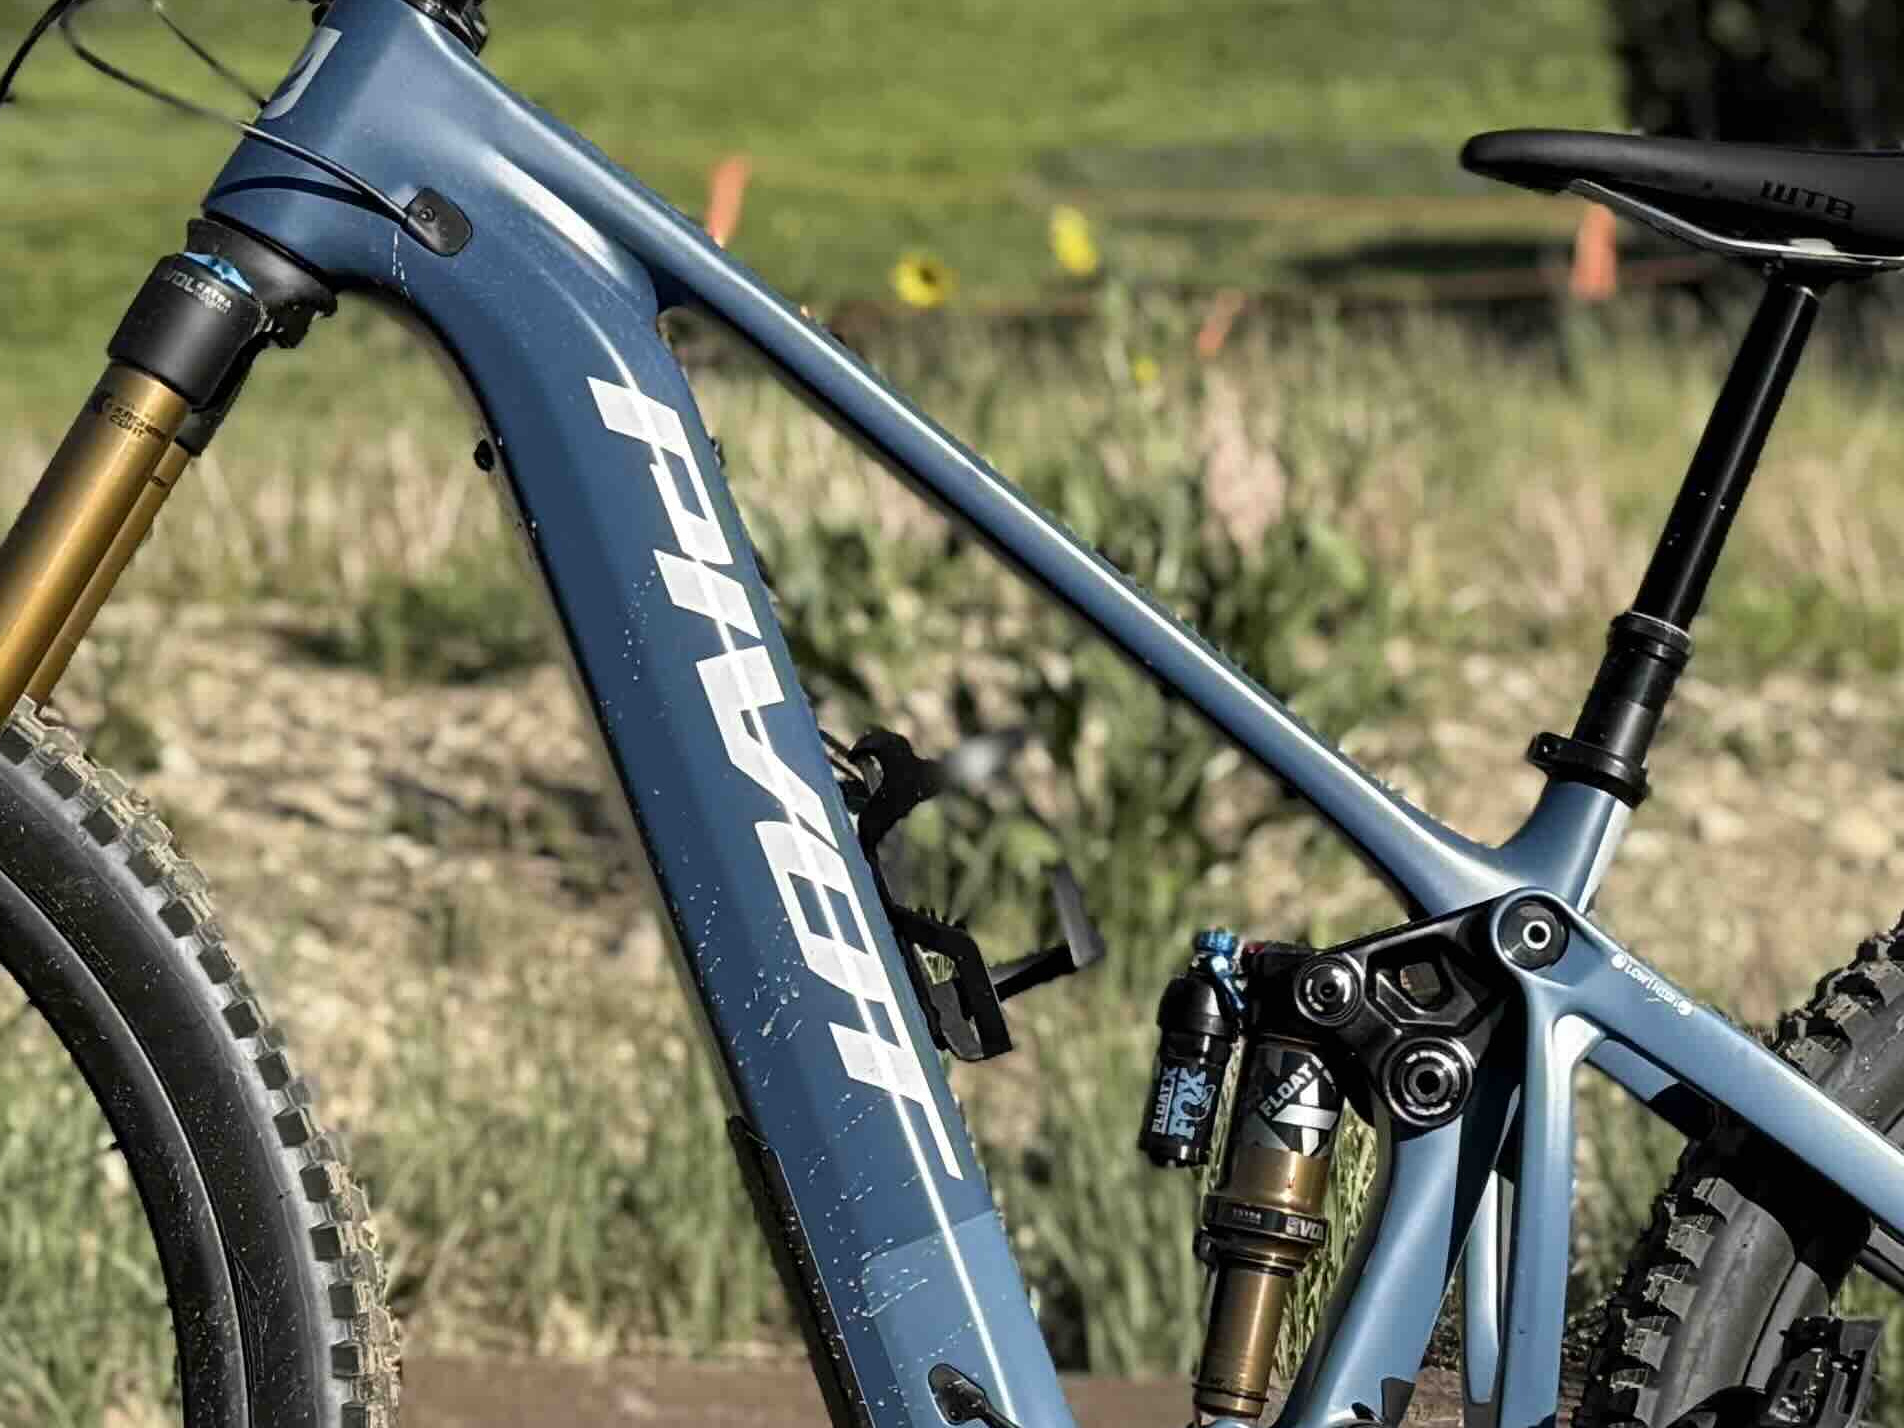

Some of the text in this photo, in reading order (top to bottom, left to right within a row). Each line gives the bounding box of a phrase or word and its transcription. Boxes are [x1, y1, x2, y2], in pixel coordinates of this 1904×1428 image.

[1760, 180, 1856, 221] WTB
[586, 376, 964, 1180] PIVOT
[1168, 1067, 1216, 1140] FOX
[1258, 1062, 1313, 1117] FLOAT
